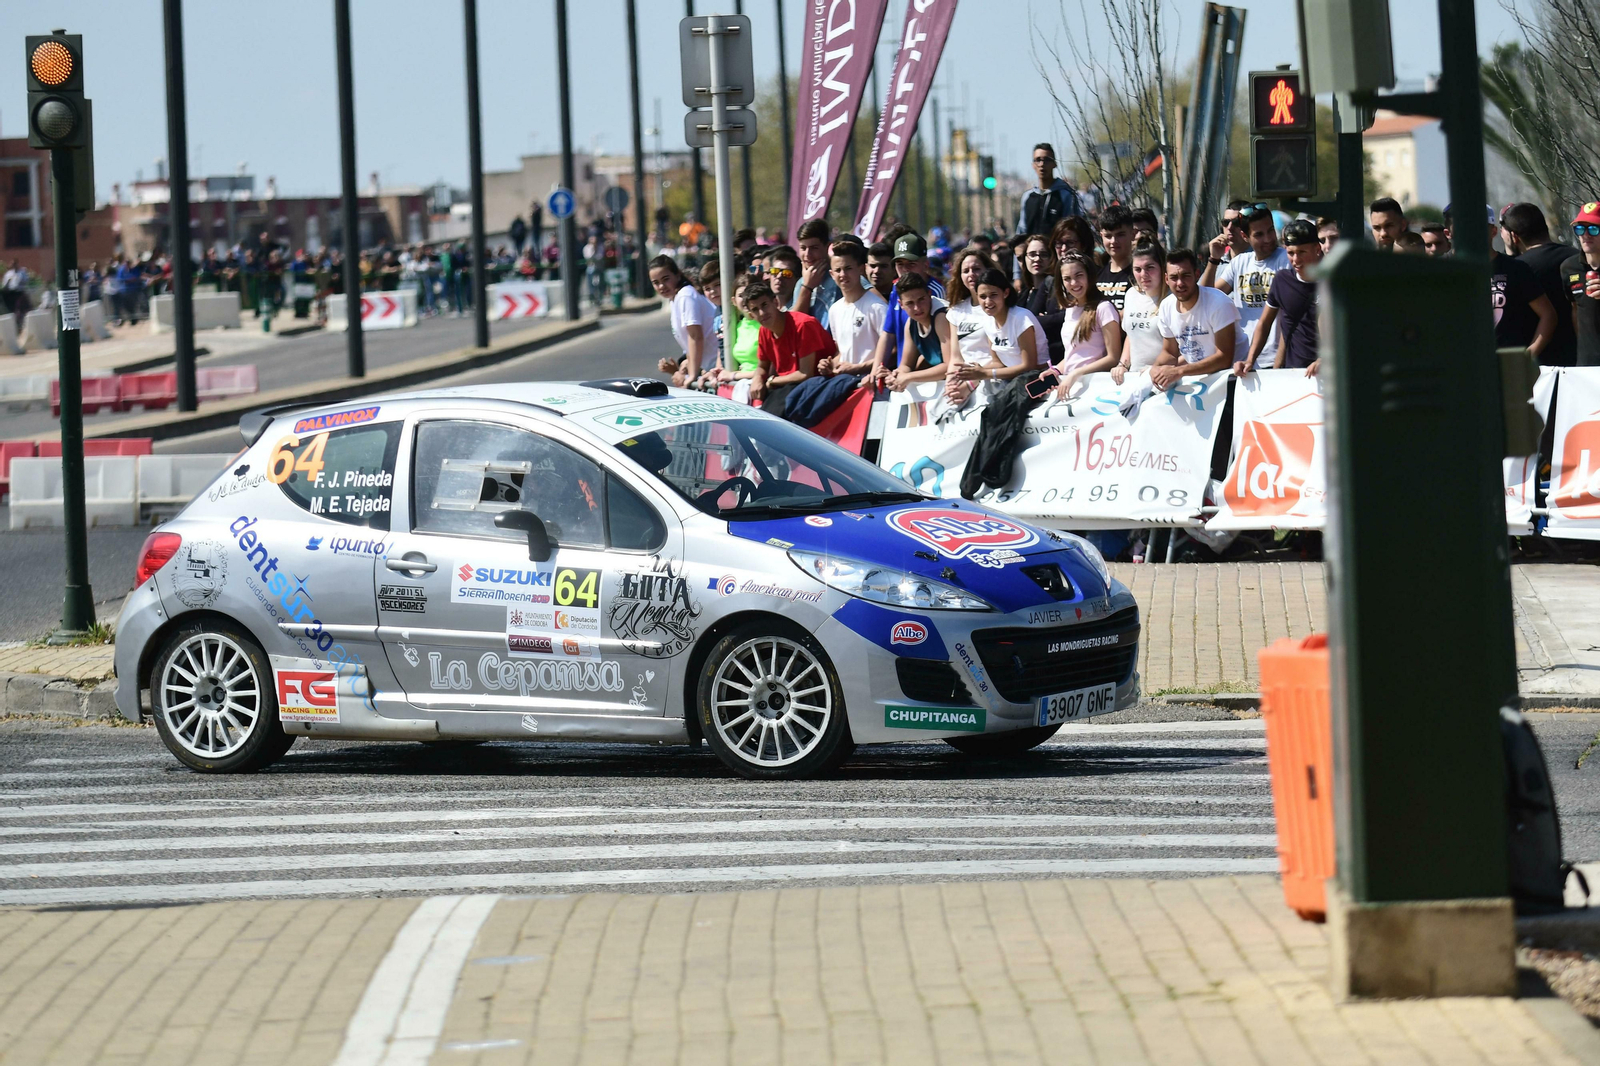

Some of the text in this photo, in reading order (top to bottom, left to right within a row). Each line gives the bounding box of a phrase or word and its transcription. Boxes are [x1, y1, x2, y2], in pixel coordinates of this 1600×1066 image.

[1131, 321, 1151, 331] yes
[294, 407, 378, 433] PALVINOX
[267, 431, 330, 484] 64
[314, 469, 392, 488] F. J. Pineda
[310, 493, 390, 516] M. E. Tejada
[1042, 487, 1075, 504] 04
[1088, 483, 1119, 502] 95
[1137, 485, 1189, 508] 08
[911, 517, 1020, 542] Albe
[475, 568, 551, 587] SUZUKI
[555, 569, 598, 608] 64
[618, 572, 694, 608] GOTA
[740, 579, 791, 599] American
[380, 600, 425, 611] ASCENSORES
[245, 576, 278, 618] cuidando
[296, 636, 323, 671] sonrisa
[571, 615, 598, 625] Diputación
[610, 602, 689, 634] Negra
[1028, 610, 1062, 625] JAVIER
[518, 638, 551, 648] IMDECO
[895, 626, 924, 640] Albe
[1047, 634, 1119, 654] LAS MONDRIGUETAS RACING
[428, 651, 625, 697] La Cepansa
[277, 670, 338, 707] FG
[280, 706, 310, 714] RACING
[1049, 687, 1112, 721] 3907 GNF
[889, 710, 977, 725] CHUPITANGA
